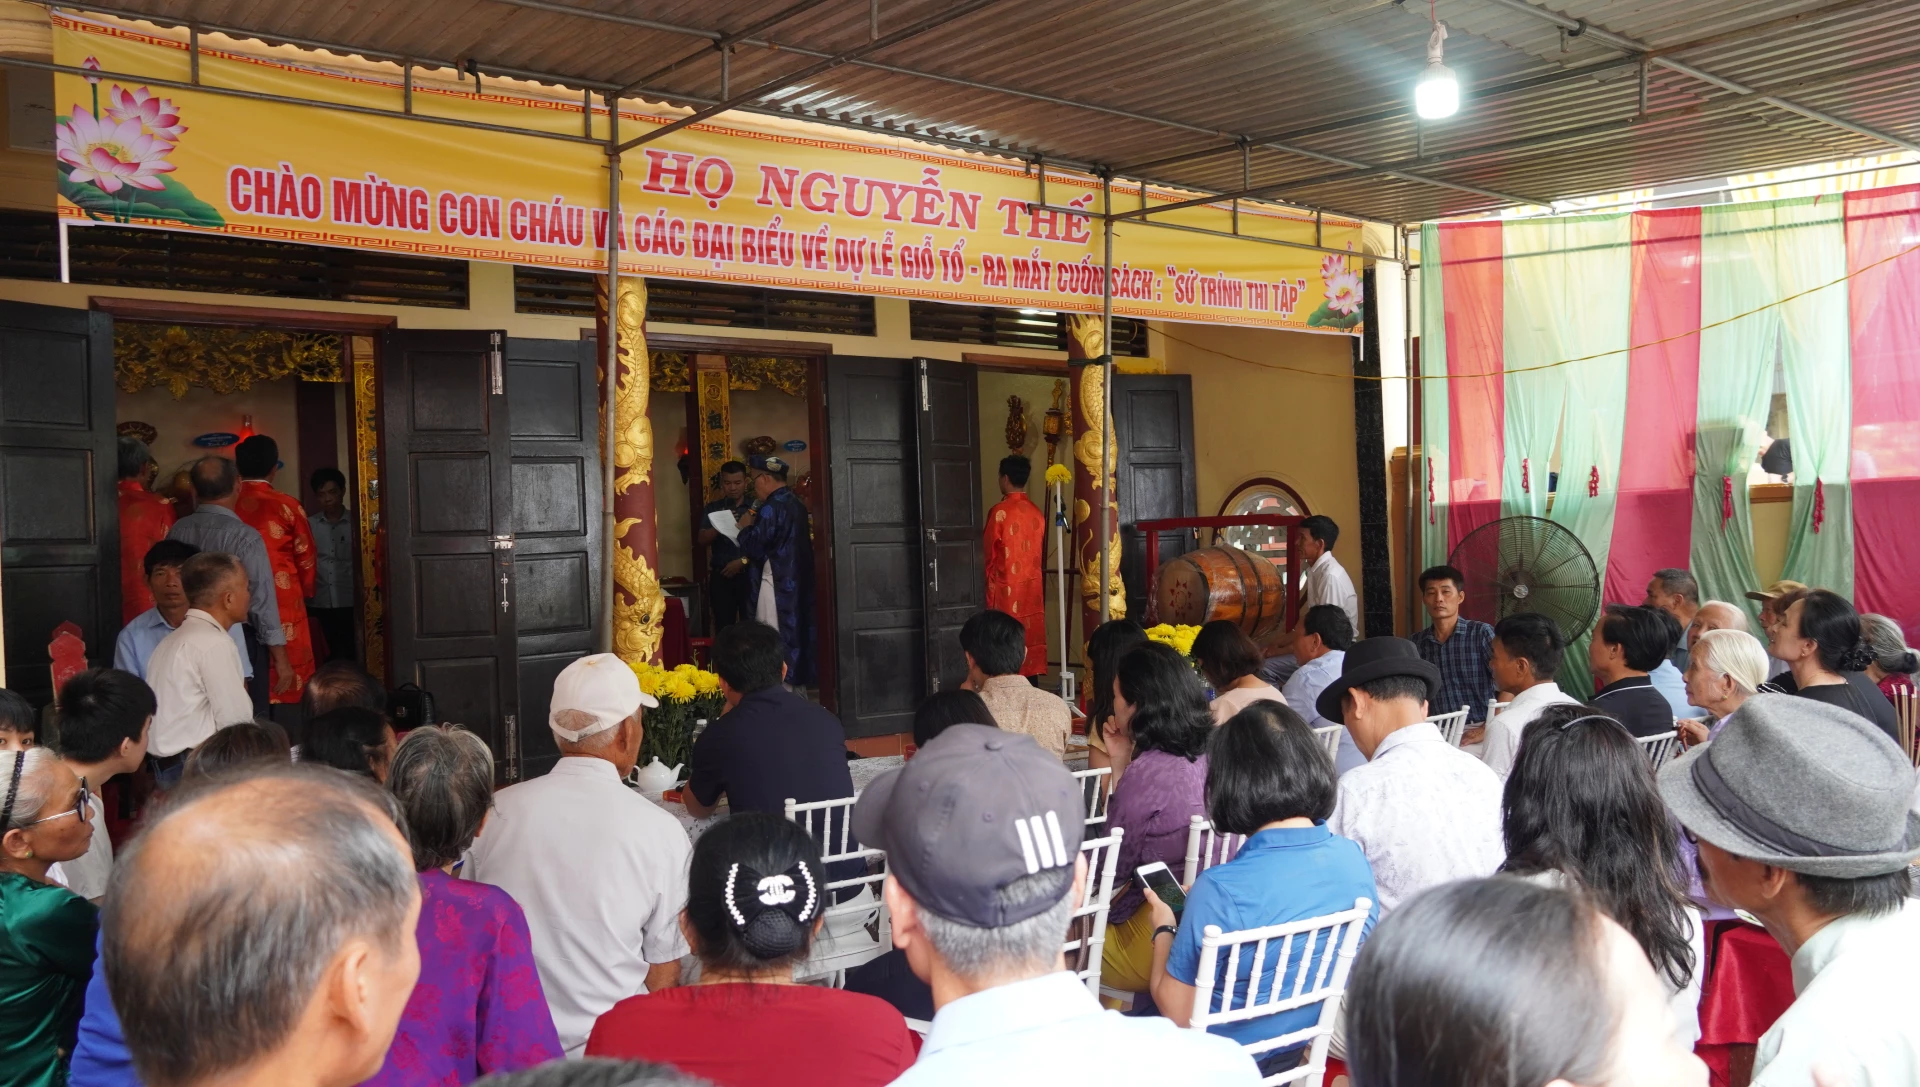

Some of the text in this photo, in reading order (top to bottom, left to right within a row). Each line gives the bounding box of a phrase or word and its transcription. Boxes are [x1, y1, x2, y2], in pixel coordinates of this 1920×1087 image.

[230, 164, 322, 220] CHÀO
[332, 174, 430, 232] MỪNG
[438, 192, 501, 238] CON
[509, 197, 585, 248] CHÁU
[633, 209, 687, 257] CÁC
[692, 221, 735, 269] ĐẠI
[741, 216, 796, 267] BIỂU
[801, 224, 829, 271] VỀ
[834, 237, 868, 282] DỰ
[870, 230, 896, 277] LỄ
[899, 235, 936, 281] GIỖ
[939, 238, 966, 283] TỔ
[982, 254, 1008, 288] RA
[1012, 247, 1052, 291] MẮT
[1056, 254, 1105, 296] CUỐN
[1199, 272, 1243, 309] TRÌNH
[1246, 281, 1269, 311] THI
[642, 149, 1094, 245] HỌ NGUYỄN THẾ
